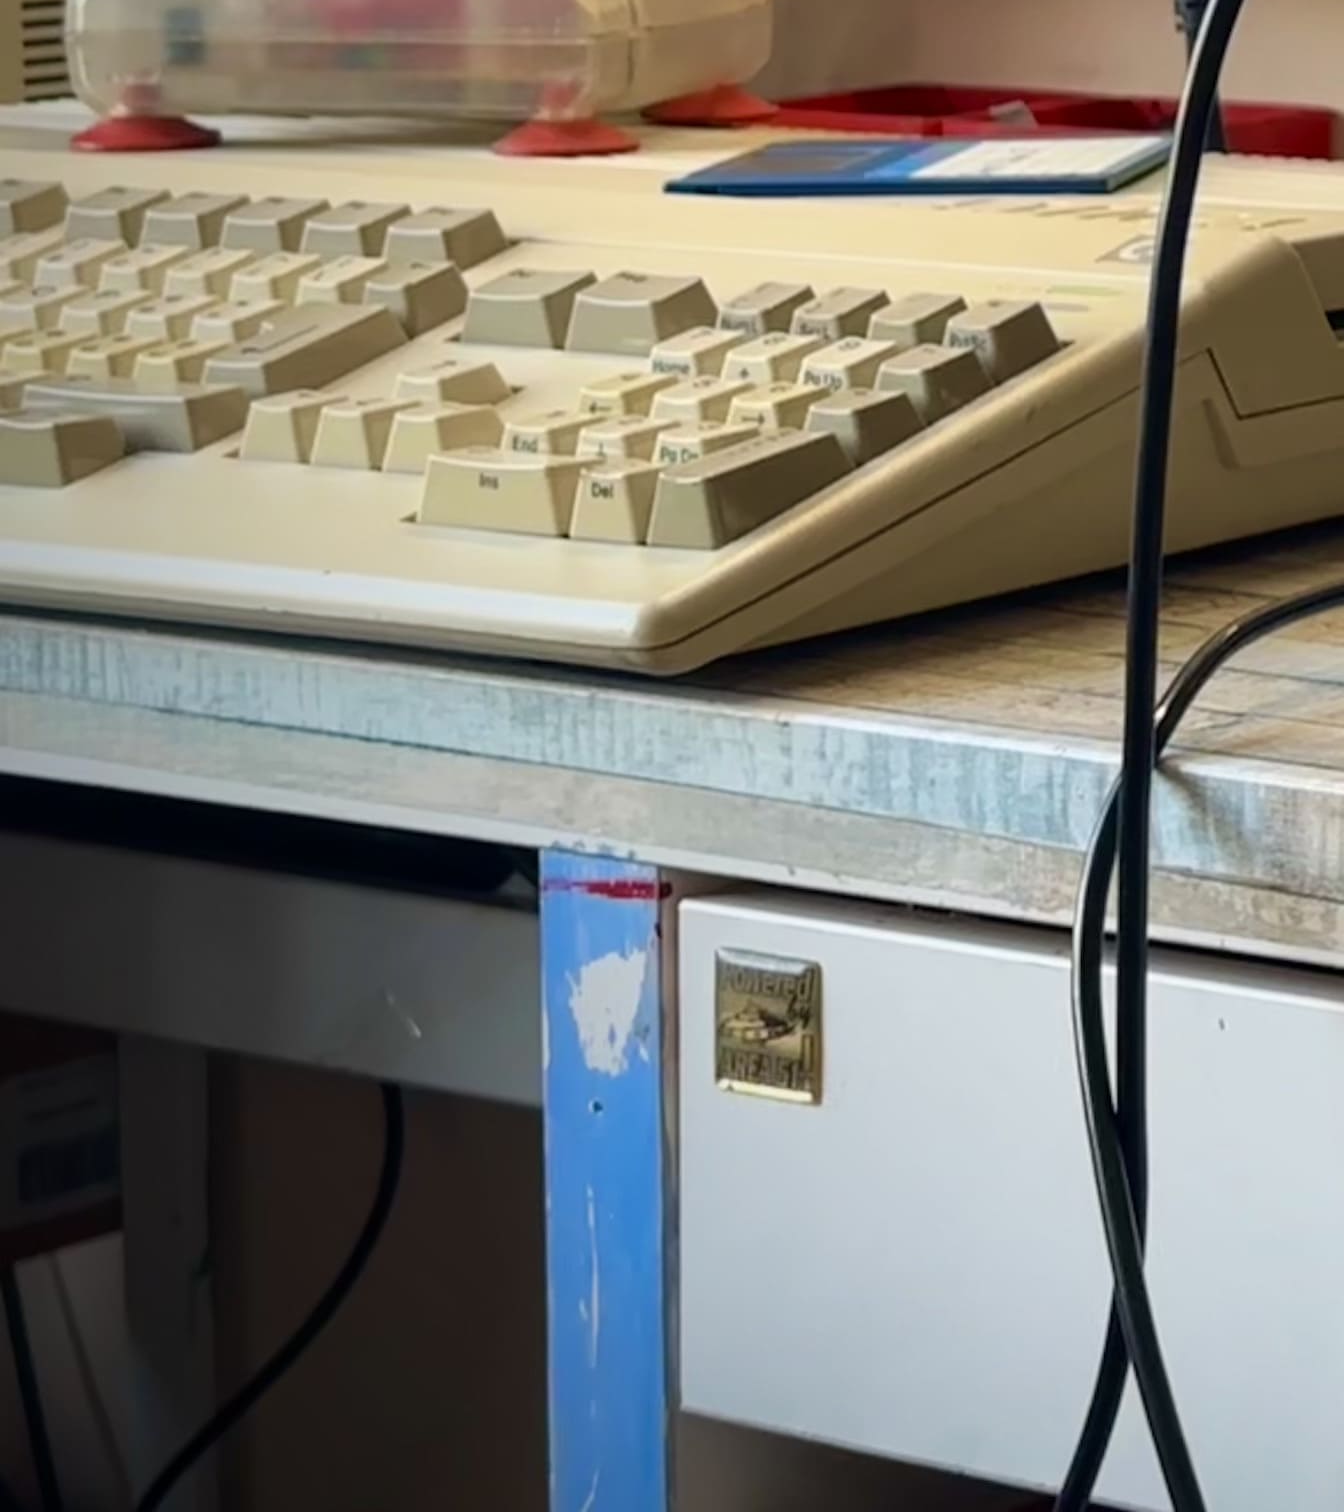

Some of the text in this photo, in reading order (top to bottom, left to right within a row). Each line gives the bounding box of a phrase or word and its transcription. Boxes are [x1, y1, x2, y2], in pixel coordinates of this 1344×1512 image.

[652, 360, 691, 374] Home
[512, 436, 539, 453] End
[479, 473, 499, 490] Ins
[591, 482, 614, 499] Del
